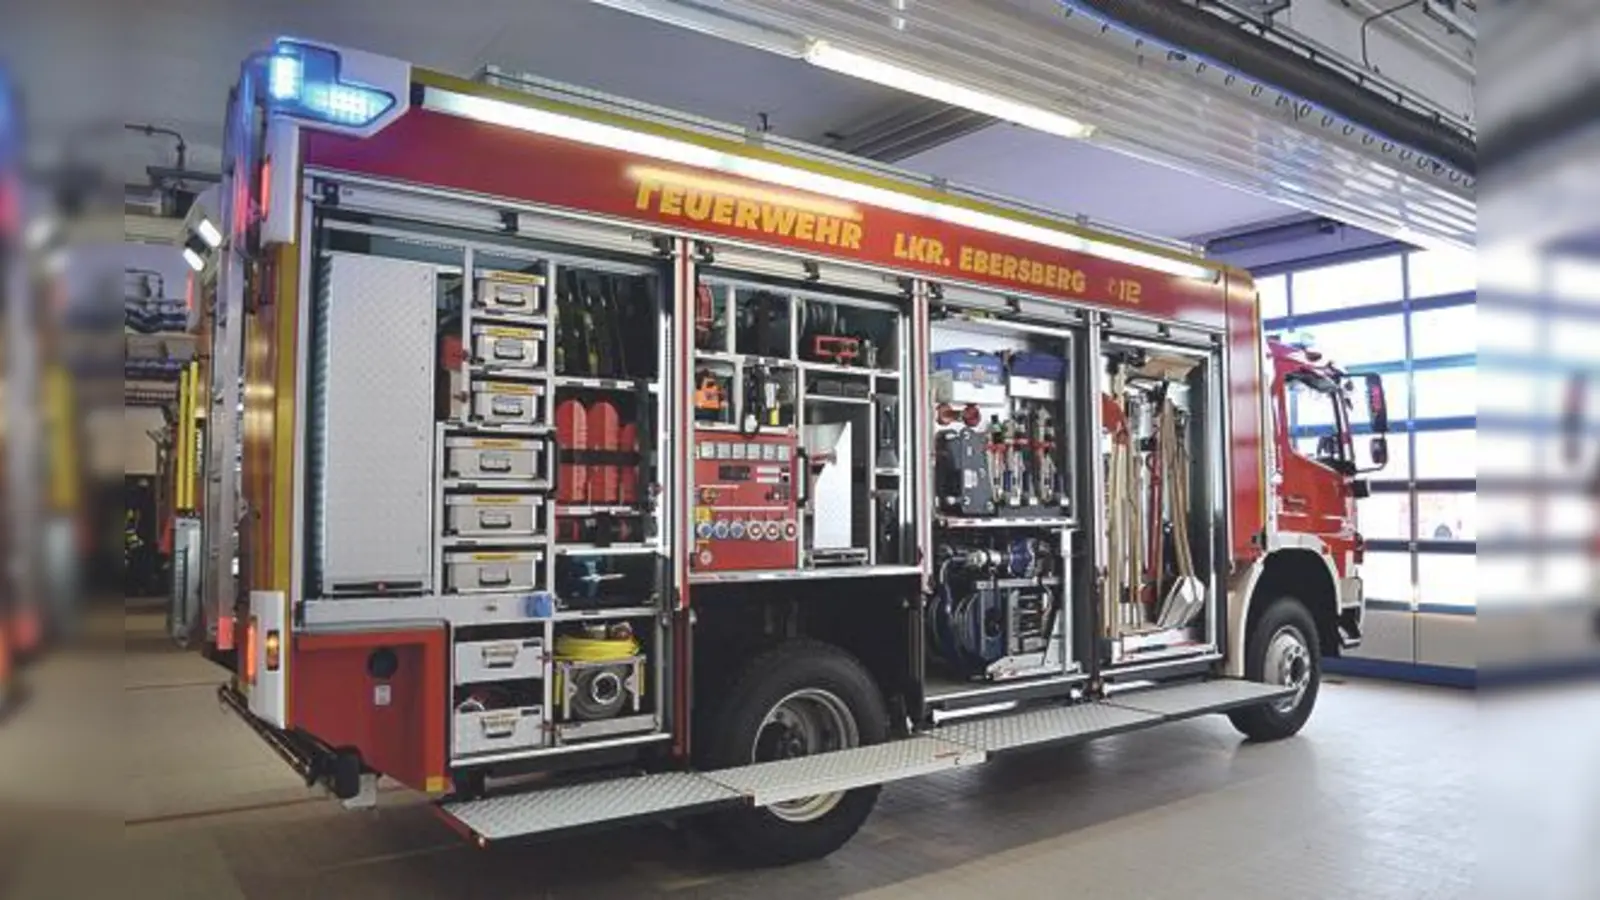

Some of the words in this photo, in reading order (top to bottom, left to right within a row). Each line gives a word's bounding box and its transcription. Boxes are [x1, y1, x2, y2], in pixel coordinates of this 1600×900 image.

[635, 177, 863, 249] FEUERWEHR
[894, 233, 950, 267] LKR.
[959, 246, 1086, 293] EBERSBERG
